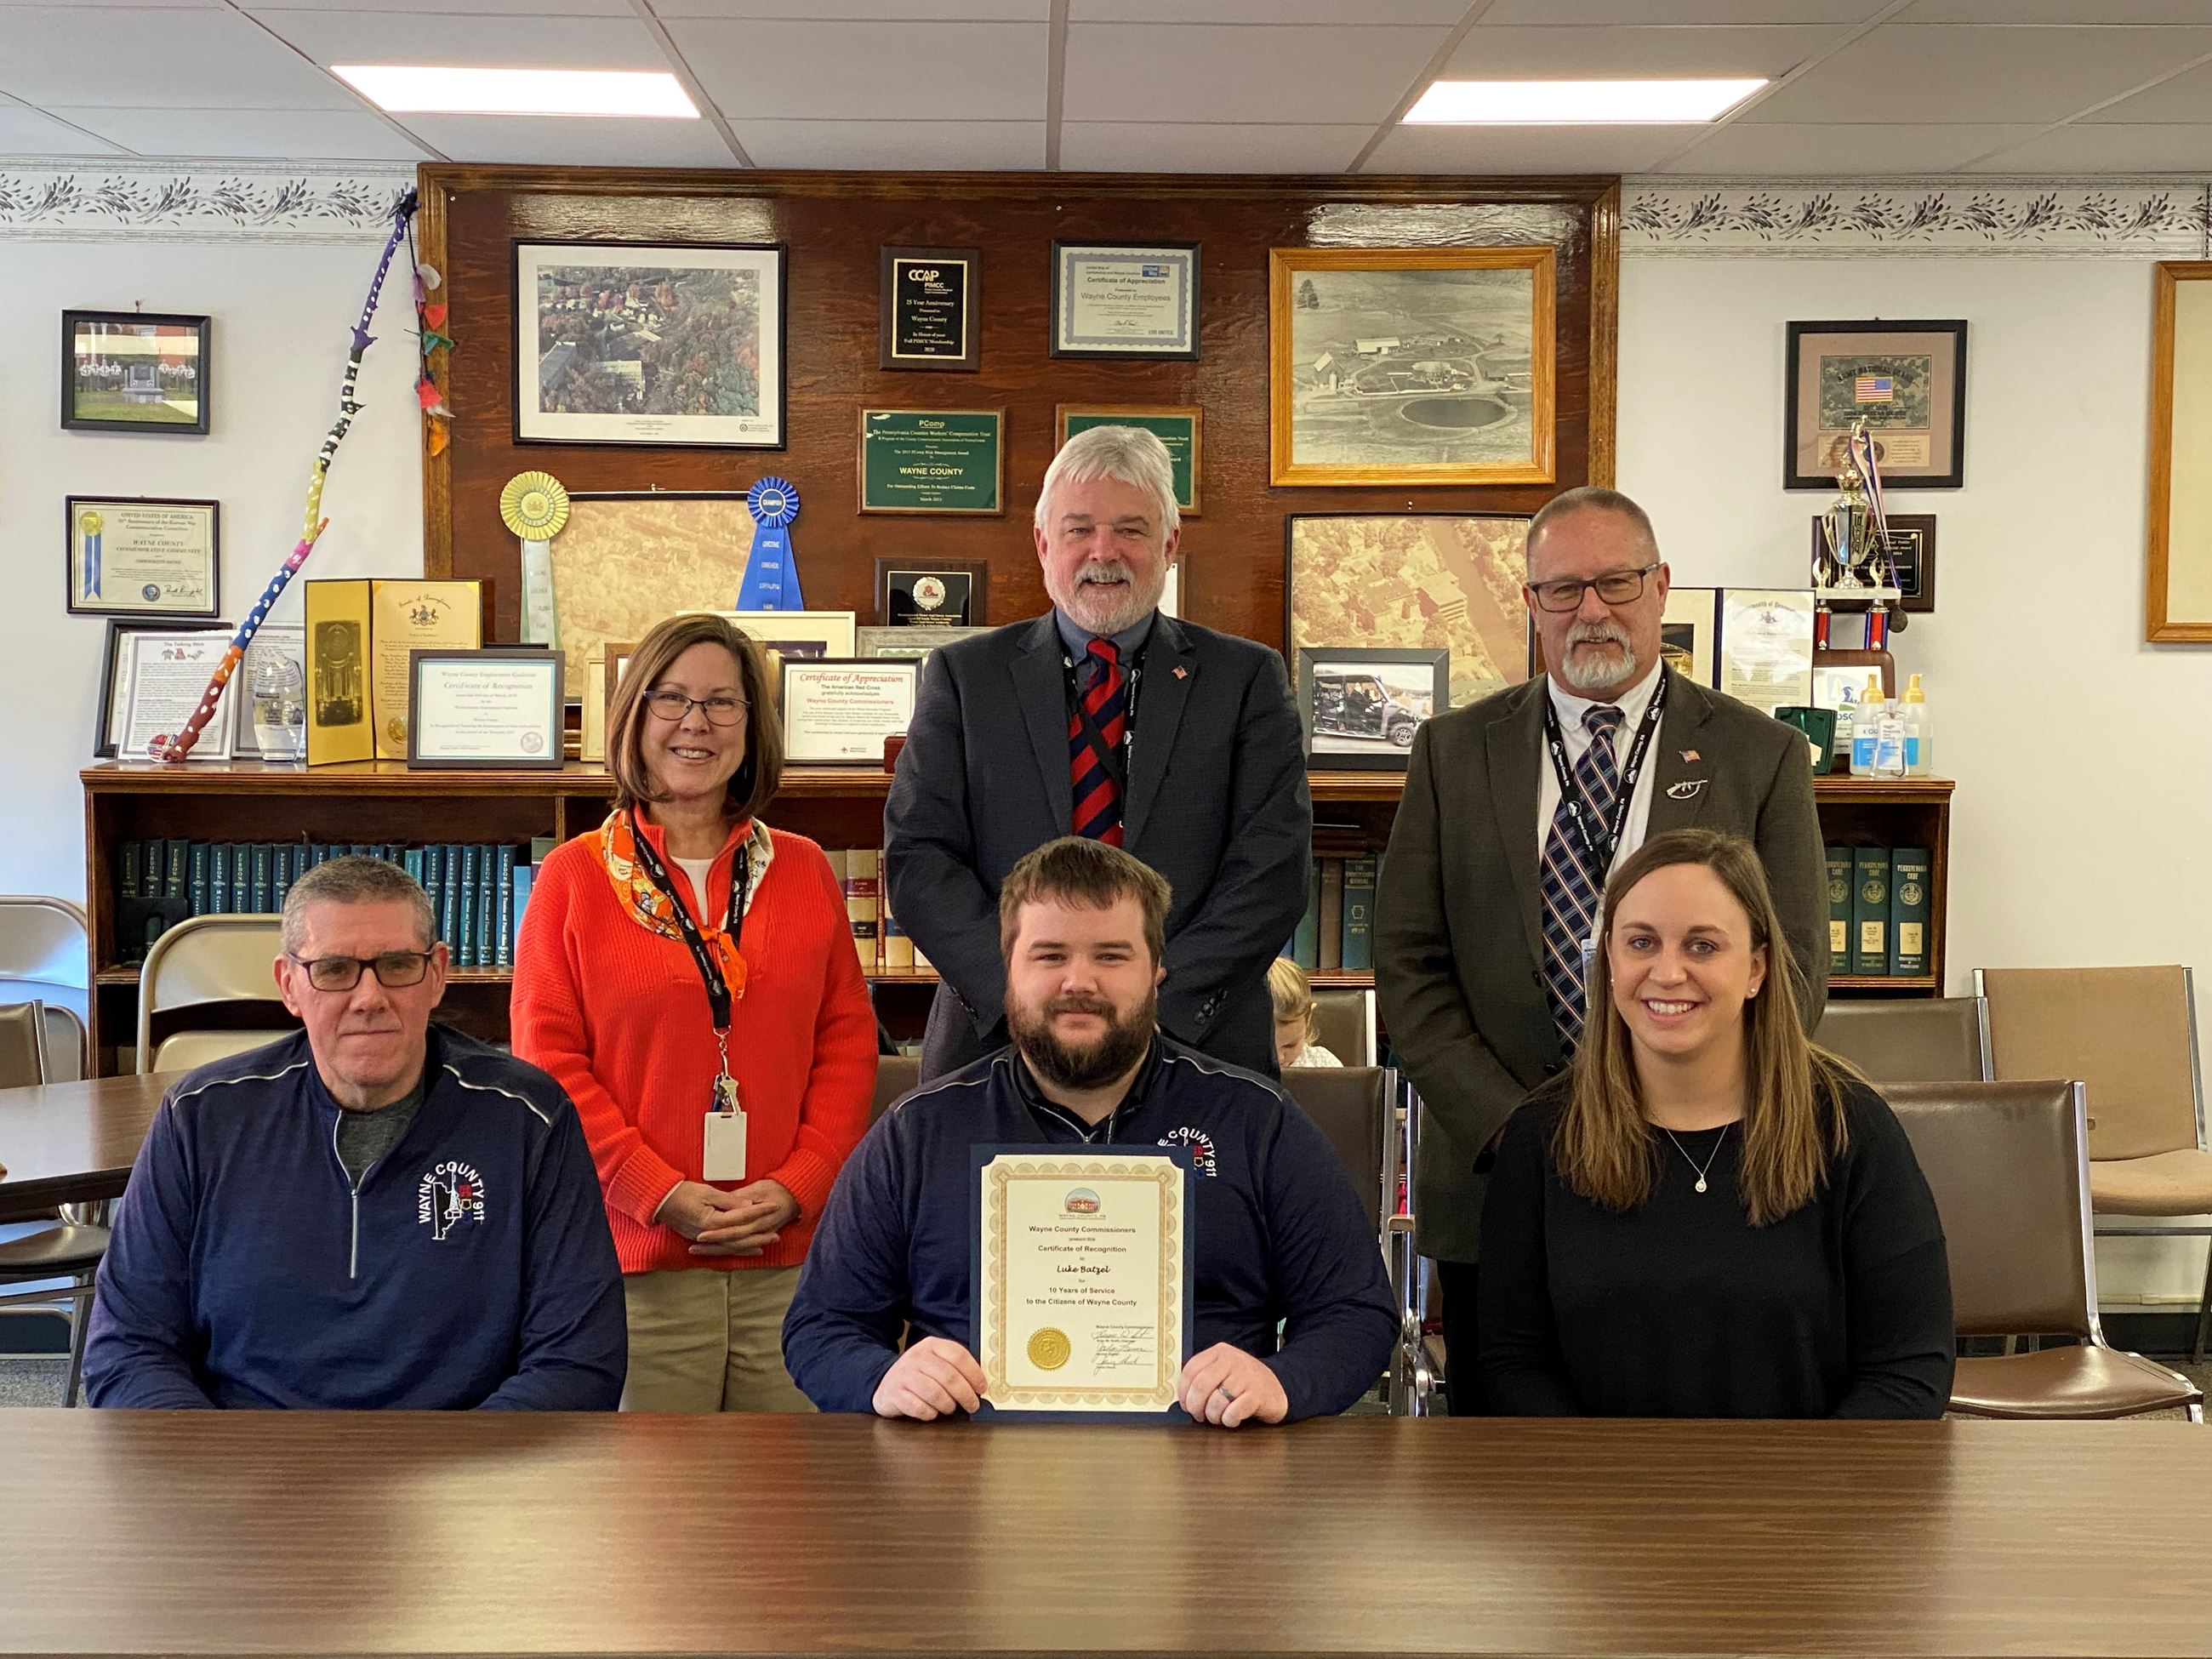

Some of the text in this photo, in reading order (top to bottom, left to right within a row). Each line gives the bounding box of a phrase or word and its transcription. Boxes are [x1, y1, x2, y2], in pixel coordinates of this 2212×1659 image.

[908, 269, 939, 282] CCAP
[1080, 293, 1171, 302] Wayne County Employees
[929, 316, 947, 324] County
[1837, 369, 1856, 383] ARMY
[919, 419, 945, 428] PComp
[899, 466, 963, 476] WAYNE COUNTY
[799, 672, 904, 685] Certificate of Appreciation
[443, 681, 482, 690] Certificate
[492, 682, 533, 691] Recognition
[1832, 868, 1844, 876] CODE
[1868, 869, 1880, 877] CODE
[1897, 864, 1927, 873] PENNSYLVANIA
[1907, 872, 1919, 881] CODE
[1167, 1126, 1217, 1177] COUNTY 911
[418, 1160, 485, 1223] WAYNE COUNTY 911
[1029, 1226, 1053, 1234] Wayne
[1054, 1226, 1079, 1234] County
[1084, 1246, 1126, 1254] Recognition
[1057, 1264, 1111, 1276] Luke Batzel
[1112, 1299, 1137, 1308] County
